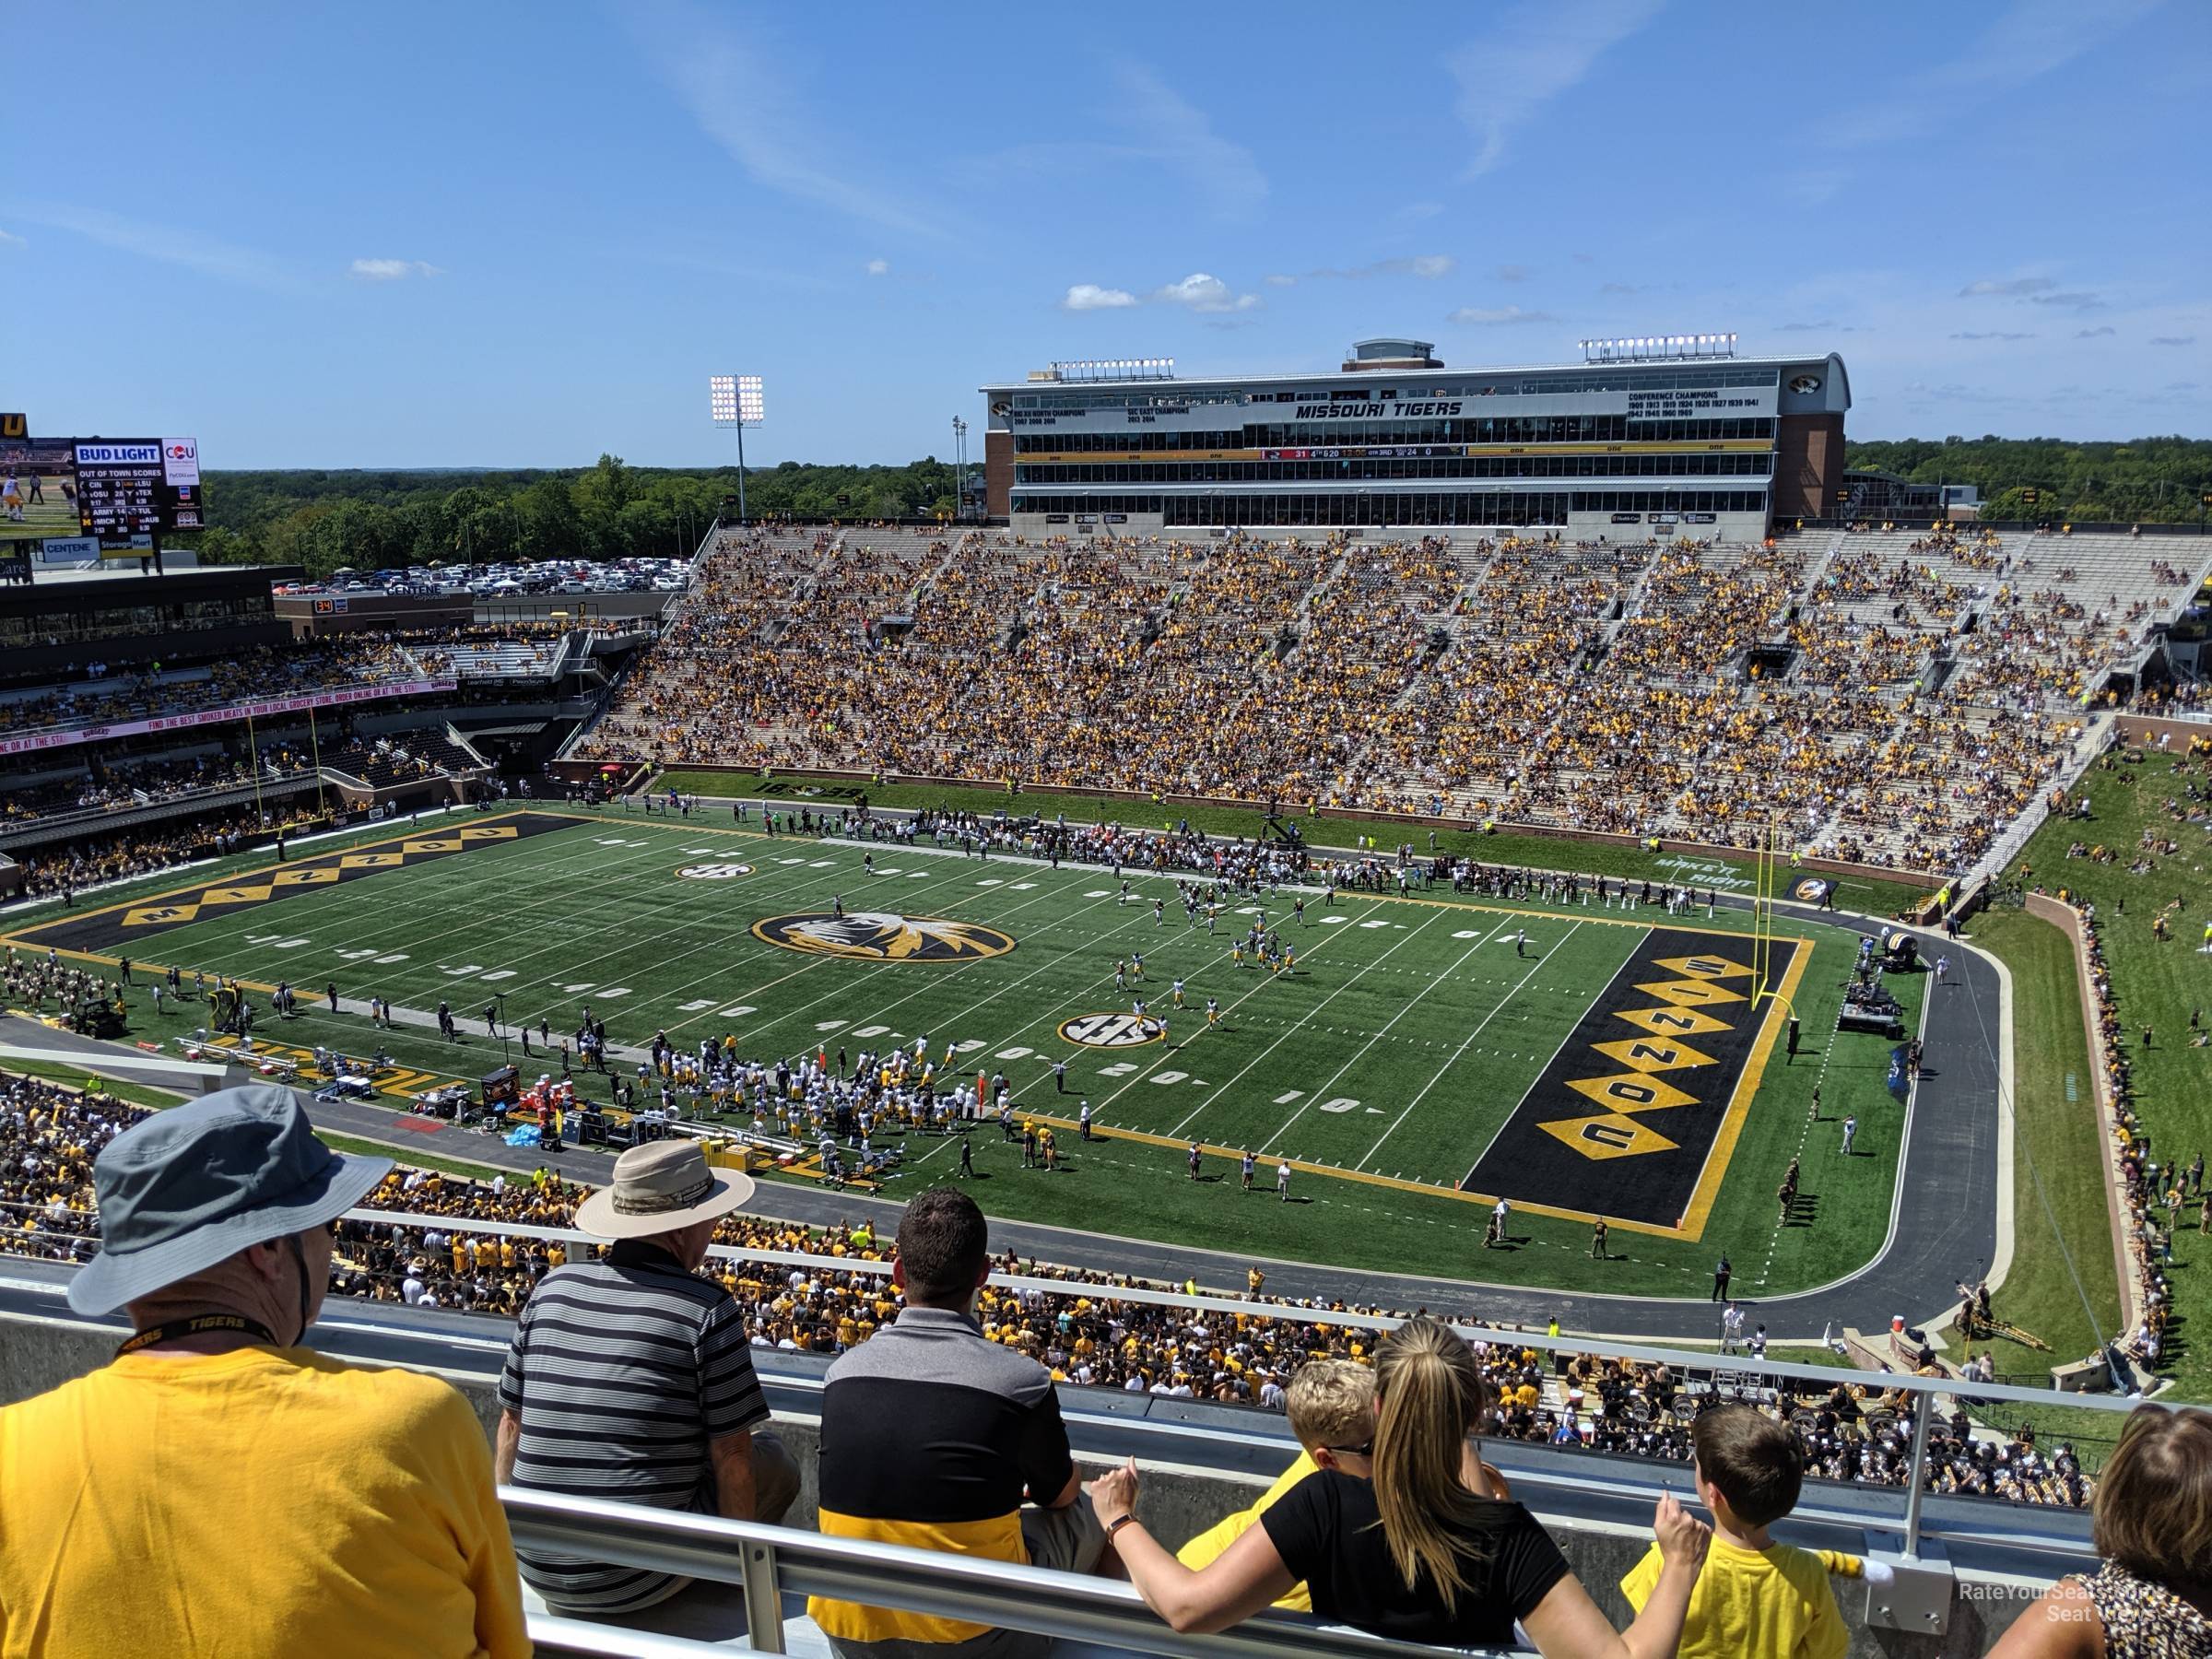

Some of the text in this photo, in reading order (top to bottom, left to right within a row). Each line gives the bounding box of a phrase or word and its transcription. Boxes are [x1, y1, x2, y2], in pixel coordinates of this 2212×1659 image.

[1629, 391, 1719, 400] CONFERENCE CHAMPIONS
[1155, 406, 1189, 415] CHAMPIONS
[1296, 402, 1463, 419] MISSOURI TIGERS
[4, 415, 24, 436] U
[79, 448, 156, 461] BUD LIGHT
[1295, 450, 1306, 458] 31
[1425, 447, 1432, 455] 0
[47, 543, 91, 554] CENTENE
[387, 585, 442, 596] CENTENE
[318, 601, 331, 611] 34
[148, 720, 163, 731] FIND
[166, 717, 178, 728] THE
[180, 715, 195, 725] BEST
[197, 712, 221, 723] SMOKED
[223, 709, 243, 719] MEATS
[253, 704, 267, 714] YOUR
[270, 702, 287, 712] LOCAL
[288, 698, 313, 709] GROCERY
[335, 692, 352, 702] ORDER
[354, 689, 371, 700] ONLINE
[373, 688, 381, 697] OR
[382, 687, 389, 696] AT
[391, 686, 402, 695] THE
[11, 741, 20, 751] OR
[24, 738, 31, 748] AT
[35, 736, 49, 747] THE
[1688, 874, 1757, 888] RIGHT
[189, 1315, 246, 1331] TIGERS
